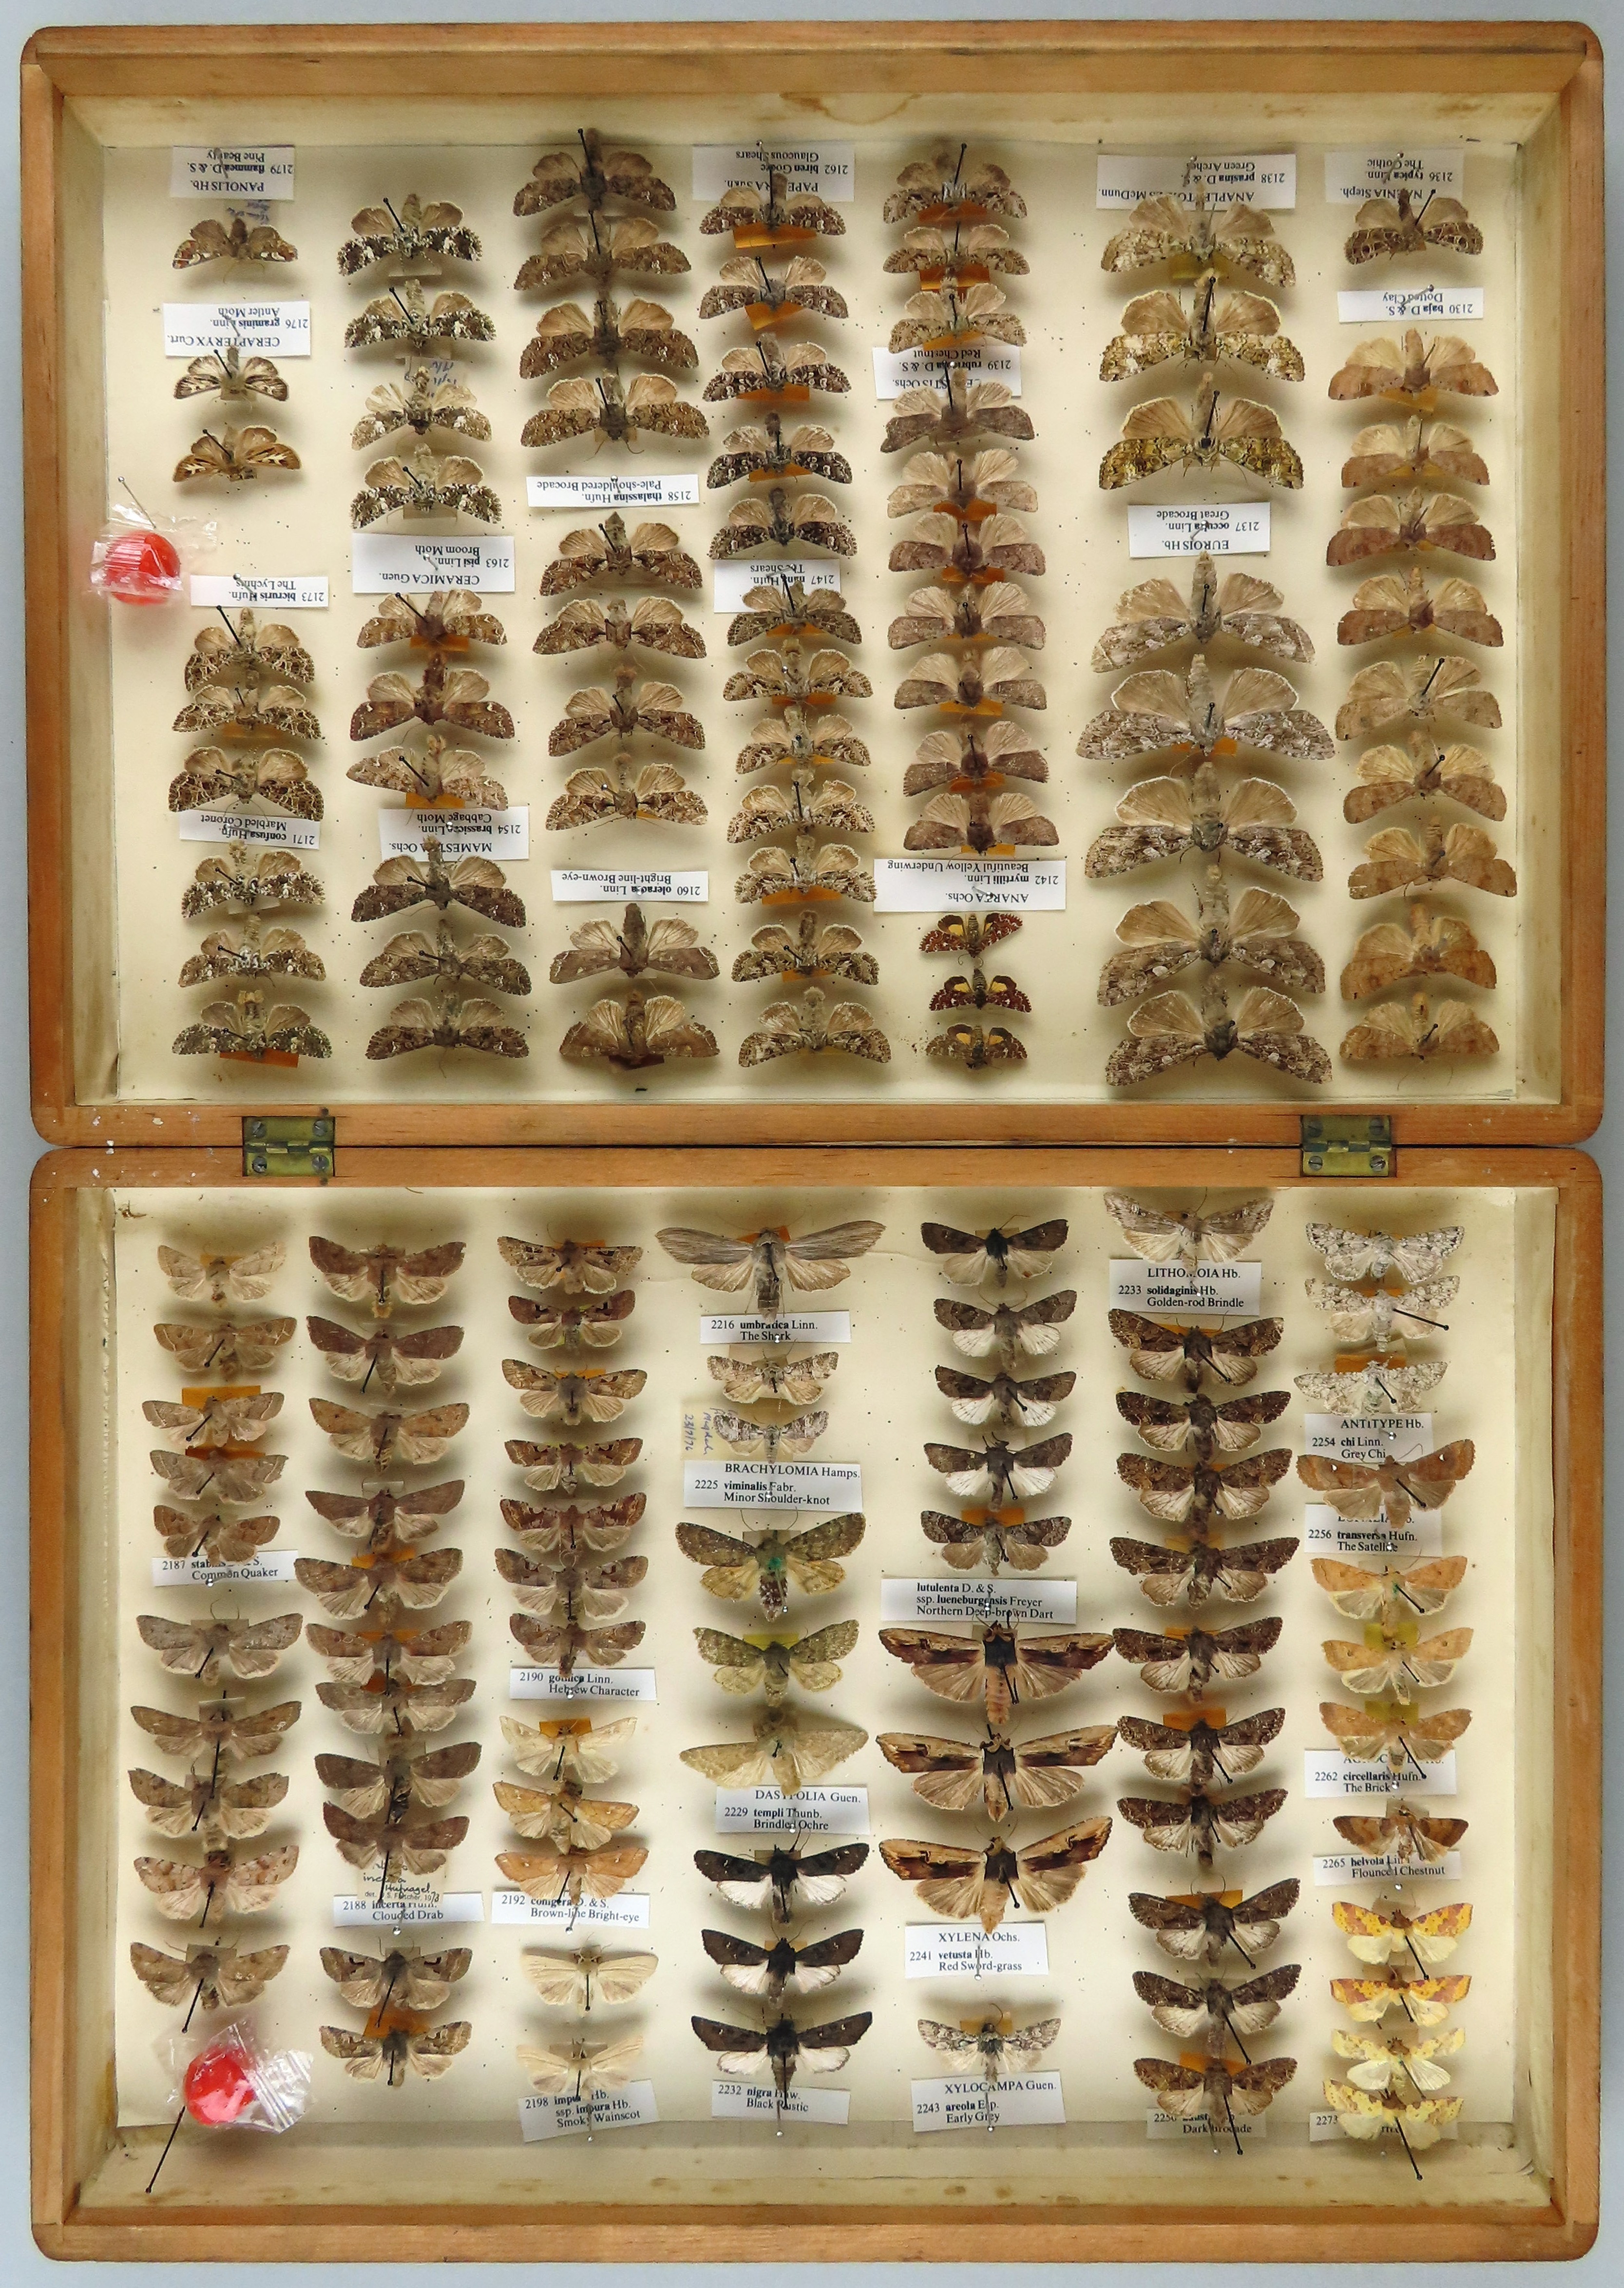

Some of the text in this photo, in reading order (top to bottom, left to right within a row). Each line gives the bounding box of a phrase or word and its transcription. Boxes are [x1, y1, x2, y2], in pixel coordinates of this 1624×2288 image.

[244, 153, 265, 162] Pine
[771, 152, 819, 162] Glaucous
[225, 164, 293, 174] 2179 flammea
[794, 165, 848, 174] 2162 biren
[1224, 163, 1255, 172] Green
[1404, 160, 1423, 169] The
[1204, 172, 1285, 184] 2138 prasina D.
[1394, 170, 1452, 182] 2136 typica
[191, 180, 264, 192] PANOLIS Hb.
[1099, 189, 1146, 201] McDunn.
[1340, 187, 1371, 197] Steph.
[1383, 292, 1405, 303] Clay
[218, 308, 280, 317] Antler Moth
[1423, 303, 1473, 314] 2130 baja
[239, 318, 308, 329] 2176 graminis
[168, 335, 280, 346] CERAPTERYX Curt.
[961, 350, 981, 358] Red
[922, 360, 1011, 371] 2139 D.
[537, 481, 578, 490] Brocade
[582, 491, 691, 503] 2158 thalassina Hufn.
[1157, 511, 1229, 519] Great Brocade
[1165, 522, 1259, 533] 2137 Linn.
[1162, 540, 1229, 550] EUROIS Hb.
[415, 545, 480, 556] Broom Moth
[435, 556, 509, 567] 2163 pisi Linn.
[379, 573, 480, 585] CERAMICA Guen.
[811, 575, 834, 584] 2147
[278, 581, 296, 590] The
[229, 592, 324, 601] 2173 bicruris Hufn.
[417, 812, 492, 823] Cabbage Moth
[201, 815, 287, 831] Marbled Coronet
[419, 825, 521, 835] 2154 Linn.
[250, 831, 287, 841] confusa
[292, 835, 315, 845] 2171
[389, 843, 418, 851] Ochs.
[888, 860, 1029, 872] Beautiful Yellow Underwing
[562, 872, 671, 884] Bright-line Brown-eye
[964, 875, 1058, 884] 2142 myrtilli Linn.
[600, 885, 700, 895] 2160 Linn.
[946, 893, 973, 902] Ochs.
[1223, 1269, 1240, 1278] Hb.
[1119, 1285, 1141, 1294] 2233
[1147, 1285, 1197, 1297] solidaginis
[1147, 1297, 1244, 1307] Golden-rod Brindle
[711, 1320, 818, 1329] 2216 Linn.
[741, 1331, 759, 1340] The
[1341, 1419, 1424, 1428] ANTITYPE Hb.
[1312, 1437, 1383, 1447] 2254 chi Linn.
[1341, 1449, 1385, 1461] Grey Chi
[725, 1464, 860, 1480] BRACHYLOMIA Hamps.
[695, 1480, 796, 1492] 2225 viminalis Fabr.
[725, 1493, 756, 1502] Minor
[1308, 1529, 1331, 1539] 2256
[1389, 1531, 1417, 1541] Hufn.
[1337, 1541, 1356, 1551] The
[162, 1560, 185, 1570] 2187
[241, 1568, 278, 1578] Quaker
[917, 1583, 974, 1593] lutulenta D.
[917, 1596, 935, 1606] ssp.
[1010, 1596, 1042, 1608] Freyer
[917, 1606, 962, 1615] Northern
[1030, 1608, 1053, 1618] Dart
[520, 1672, 613, 1684] 2190 Linn.
[590, 1685, 639, 1696] Character
[1315, 1772, 1337, 1781] 2262
[1343, 1772, 1390, 1781] circellaris
[1344, 1783, 1391, 1792] The Brick
[830, 1792, 860, 1803] Guen.
[725, 1807, 783, 1819] 2229 templi
[799, 1821, 828, 1830] Ochre
[1323, 1857, 1384, 1868] 2265 helvola
[1399, 1866, 1445, 1876] Chestnut
[502, 1895, 525, 1904] 2192
[343, 1901, 366, 1910] 2188
[418, 1910, 443, 1920] Drab
[589, 1908, 639, 1923] Bright-eye
[939, 1932, 1019, 1942] XYLENA Ochs.
[910, 1950, 972, 1961] 2241 vetusta
[939, 1961, 1022, 1972] Red Sword-grass
[718, 2085, 772, 2098] 2232 nigra
[945, 2080, 1056, 2094] XYLOCAMPA Guen.
[526, 2098, 549, 2109] 2198
[746, 2097, 773, 2109] Black
[917, 2100, 975, 2114] 2243 areola
[555, 2100, 630, 2117] ssp. Hb.
[594, 2110, 640, 2122] Wainscot
[947, 2113, 973, 2124] Early
[1183, 2124, 1207, 2134] Dark
